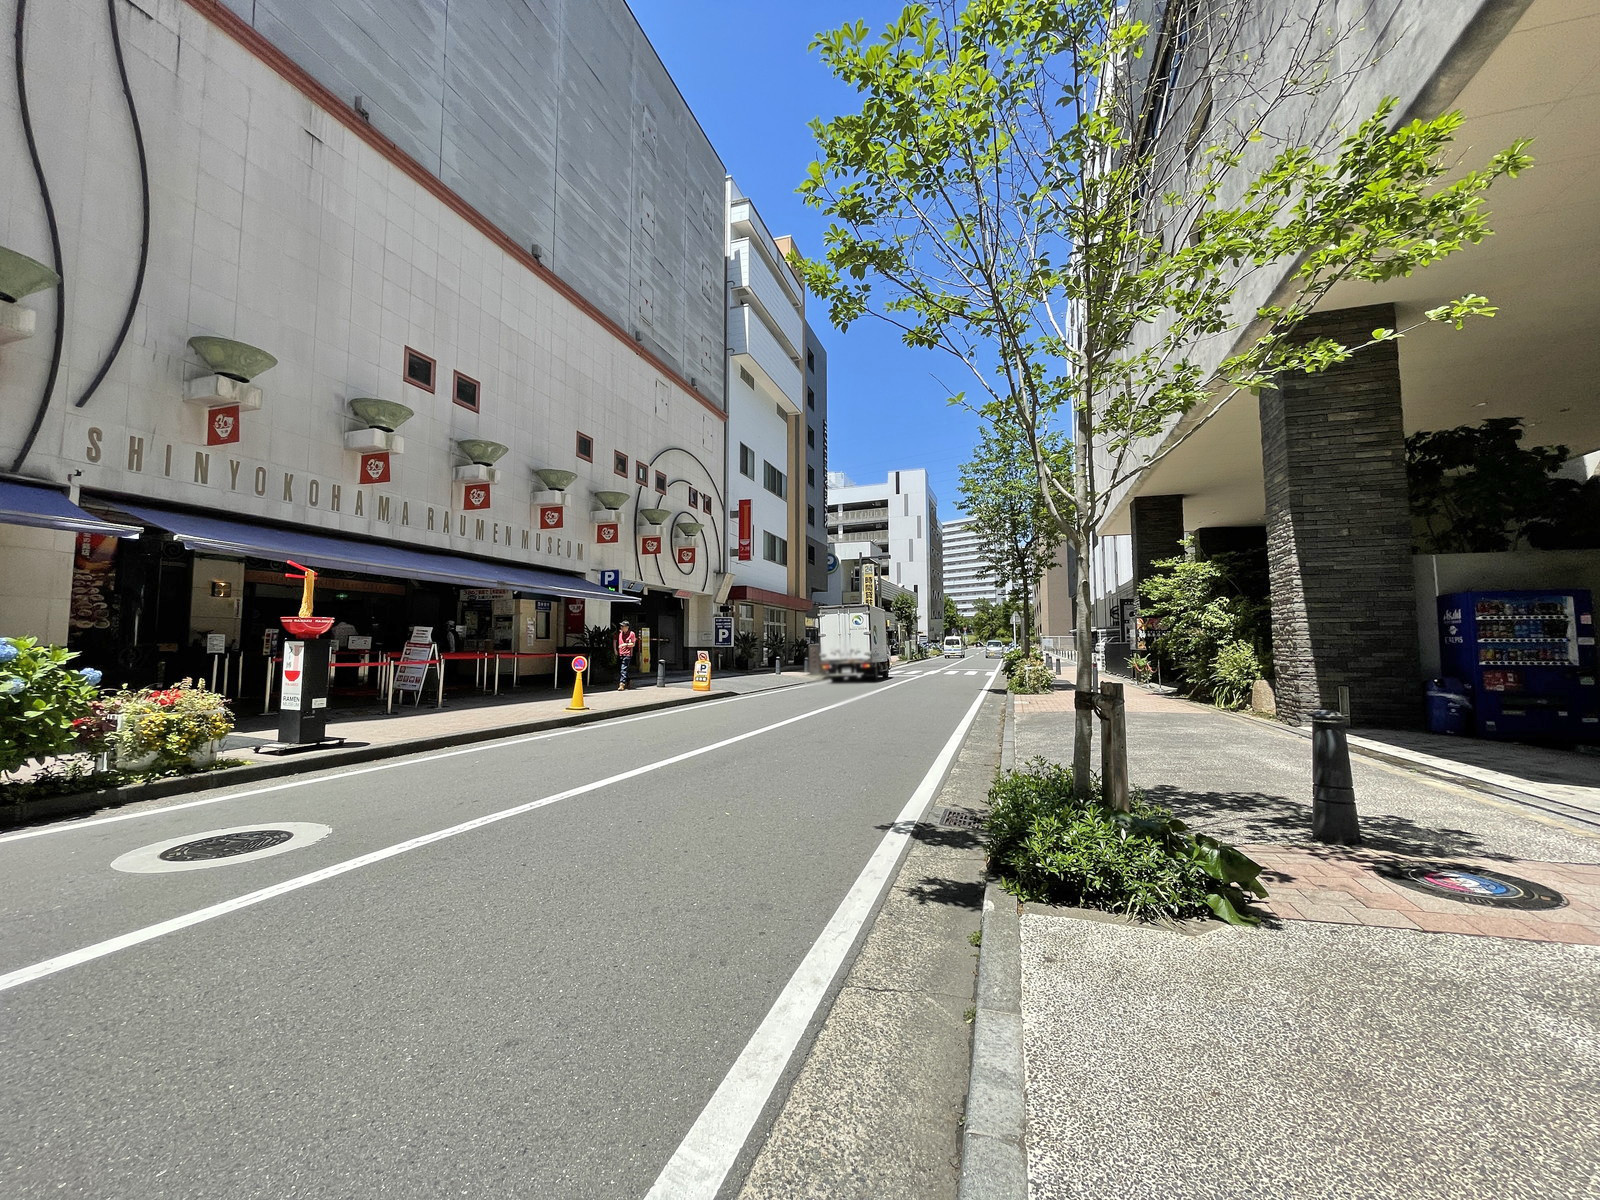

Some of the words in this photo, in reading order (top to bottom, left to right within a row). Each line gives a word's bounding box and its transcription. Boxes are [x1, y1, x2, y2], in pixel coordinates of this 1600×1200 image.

[86, 426, 410, 526] SHINYOKOHAMA
[427, 507, 512, 547] RAUMEN
[521, 529, 585, 561] MUSEUM
[604, 571, 615, 585] P
[718, 629, 729, 642] P
